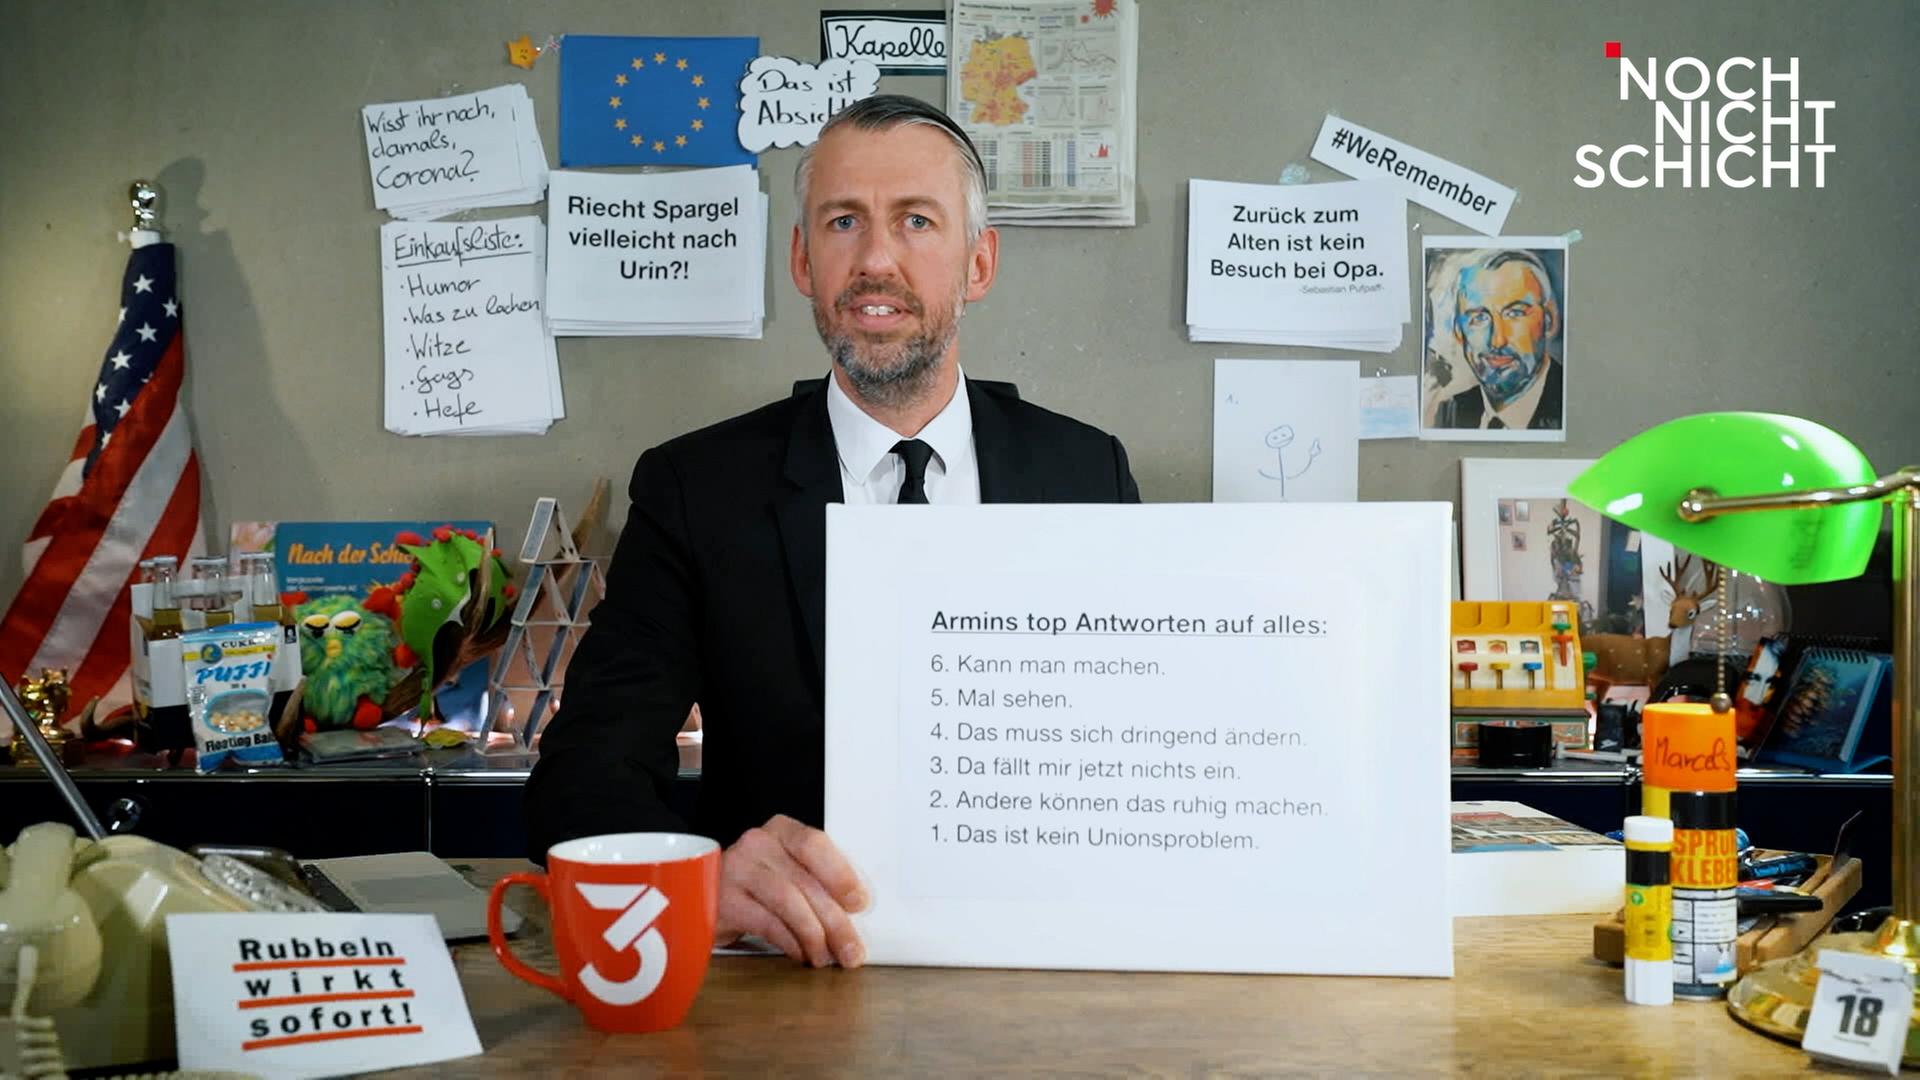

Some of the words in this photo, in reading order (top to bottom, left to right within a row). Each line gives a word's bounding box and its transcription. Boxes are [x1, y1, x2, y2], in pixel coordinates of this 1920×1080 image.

[835, 26, 946, 61] Kapelle
[757, 69, 813, 93] Das
[829, 70, 856, 93] ist
[366, 106, 410, 133] Wisst
[418, 104, 444, 127] ihr
[447, 97, 495, 123] noch,
[372, 129, 456, 158] damals,
[376, 149, 480, 189] Corona?
[1331, 127, 1497, 217] #WeRemember
[568, 195, 646, 219] Riecht
[653, 197, 738, 224] Spargel
[1233, 205, 1306, 224] Zurück
[1313, 208, 1359, 224] zum
[568, 227, 676, 250] vielleicht
[683, 228, 737, 248] nach
[1227, 232, 1280, 252] Alten
[1287, 233, 1313, 252] ist
[1320, 233, 1365, 252] kein
[620, 260, 689, 280] Urin?!
[1210, 258, 1287, 280] Besuch
[1294, 261, 1326, 280] bei
[1333, 260, 1384, 282] Opa.
[406, 273, 480, 297] Humor
[408, 304, 445, 324] Was
[452, 308, 478, 321] zu
[485, 293, 540, 316] lachen
[410, 332, 472, 361] Witze
[416, 365, 474, 394] Gags
[424, 393, 483, 425] Hefe
[287, 543, 334, 565] Nach
[337, 543, 368, 565] der
[931, 610, 1019, 631] Armins
[1026, 613, 1067, 636] top
[1075, 612, 1206, 633] Antworten
[1215, 614, 1255, 634] auf
[1263, 614, 1328, 635] alles:
[930, 654, 950, 673] 6.
[957, 655, 1012, 674] Kann
[1020, 659, 1066, 675] man
[1073, 657, 1166, 677] machen.
[930, 688, 949, 707] 5.
[957, 688, 995, 708] Mal
[1002, 690, 1073, 709] sehen.
[929, 722, 949, 742] 4.
[957, 722, 999, 742] Das
[1005, 727, 1064, 744] muss
[1070, 725, 1114, 744] sich
[1120, 726, 1217, 750] dringend
[1224, 728, 1308, 747] ändern.
[929, 756, 949, 775] 3.
[957, 756, 986, 776] Da
[993, 757, 1031, 777] fällt
[1038, 759, 1072, 777] mir
[1078, 759, 1124, 783] jetzt
[1131, 761, 1197, 780] nichts
[1203, 762, 1241, 781] ein.
[929, 789, 949, 809] 2.
[956, 790, 1033, 811] Andere
[1039, 792, 1119, 813] können
[1126, 795, 1166, 814] das
[1172, 796, 1228, 820] ruhig
[1235, 798, 1329, 817] machen.
[931, 823, 949, 844] 1.
[957, 824, 998, 845] Das
[1005, 825, 1030, 846] ist
[1036, 826, 1080, 847] kein
[1087, 827, 1261, 853] Unionsproblem.
[238, 937, 395, 962] Rubbeln
[575, 882, 670, 1006] 3
[245, 966, 407, 998] wirkt
[250, 1002, 414, 1040] sofort!
[1836, 995, 1884, 1038] 18
